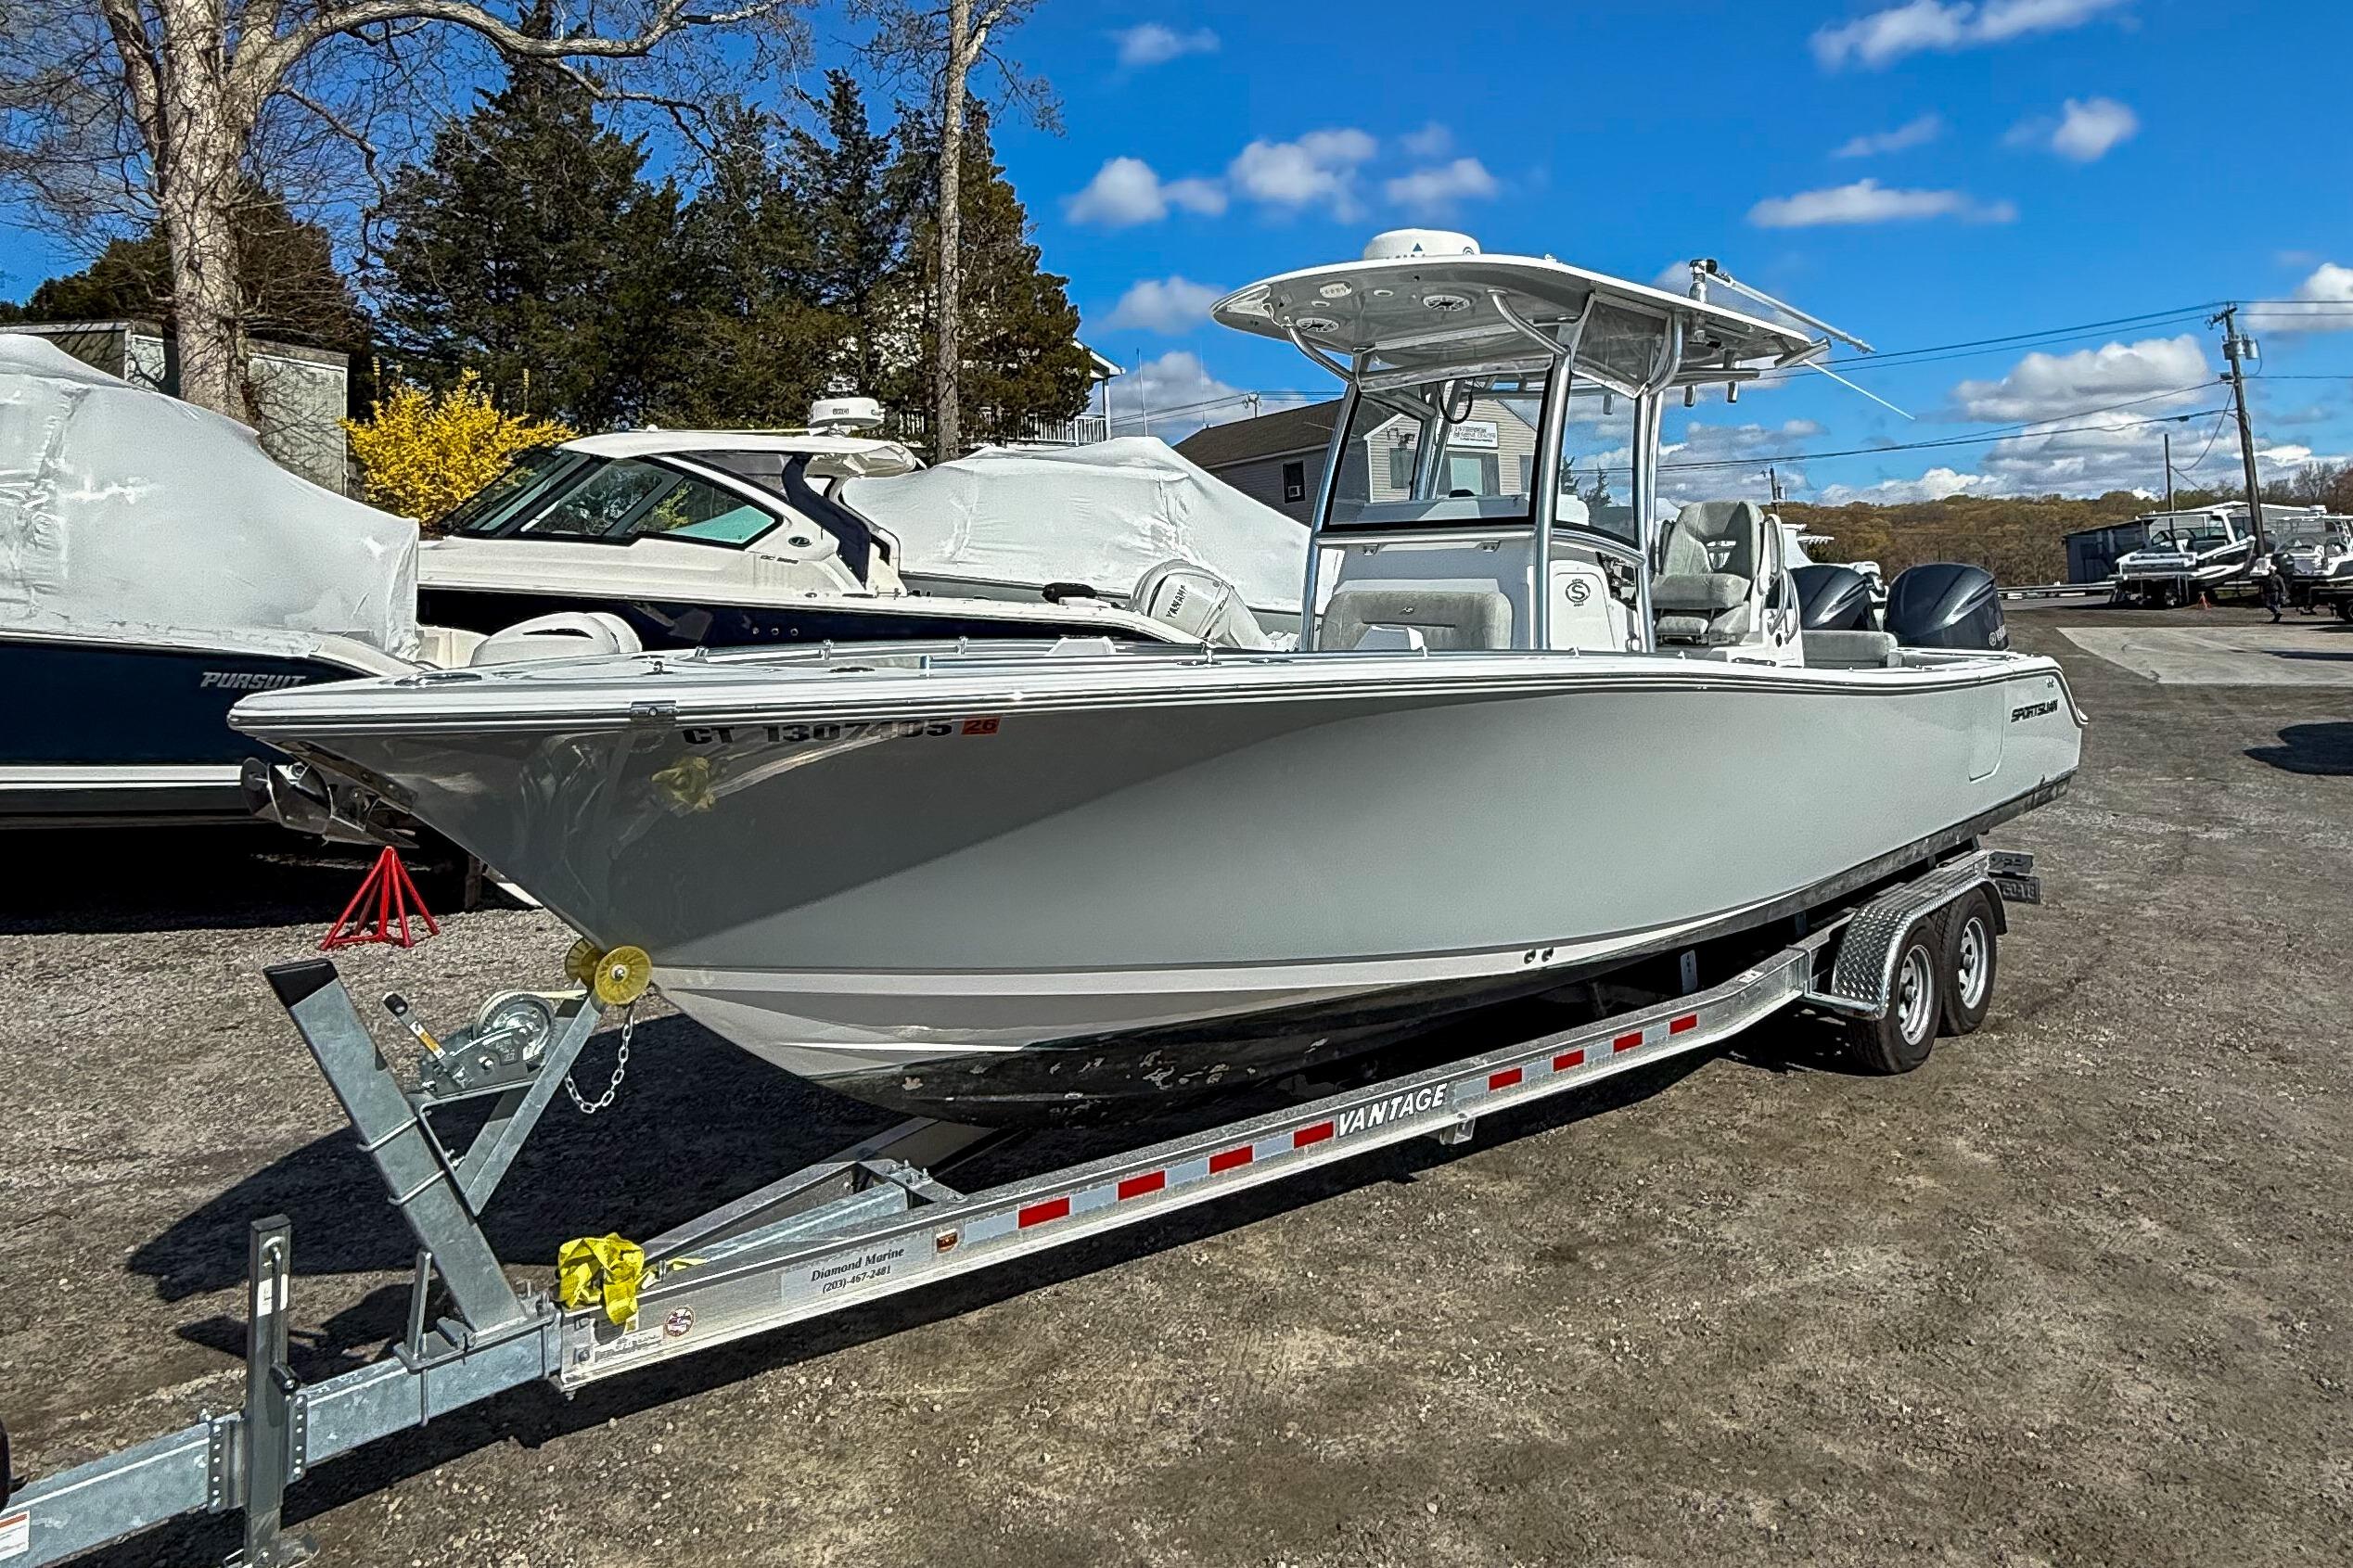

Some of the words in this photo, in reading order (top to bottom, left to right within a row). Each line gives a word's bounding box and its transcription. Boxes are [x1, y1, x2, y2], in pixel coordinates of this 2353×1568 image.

[200, 671, 307, 689] PURSUIT
[682, 726, 735, 745] CT
[965, 719, 998, 733] 26
[1337, 1081, 1448, 1138] VANTAGE
[810, 1256, 863, 1282] Diamond
[864, 1247, 905, 1268] Marine
[822, 1264, 891, 1294] (203)-467-2481
